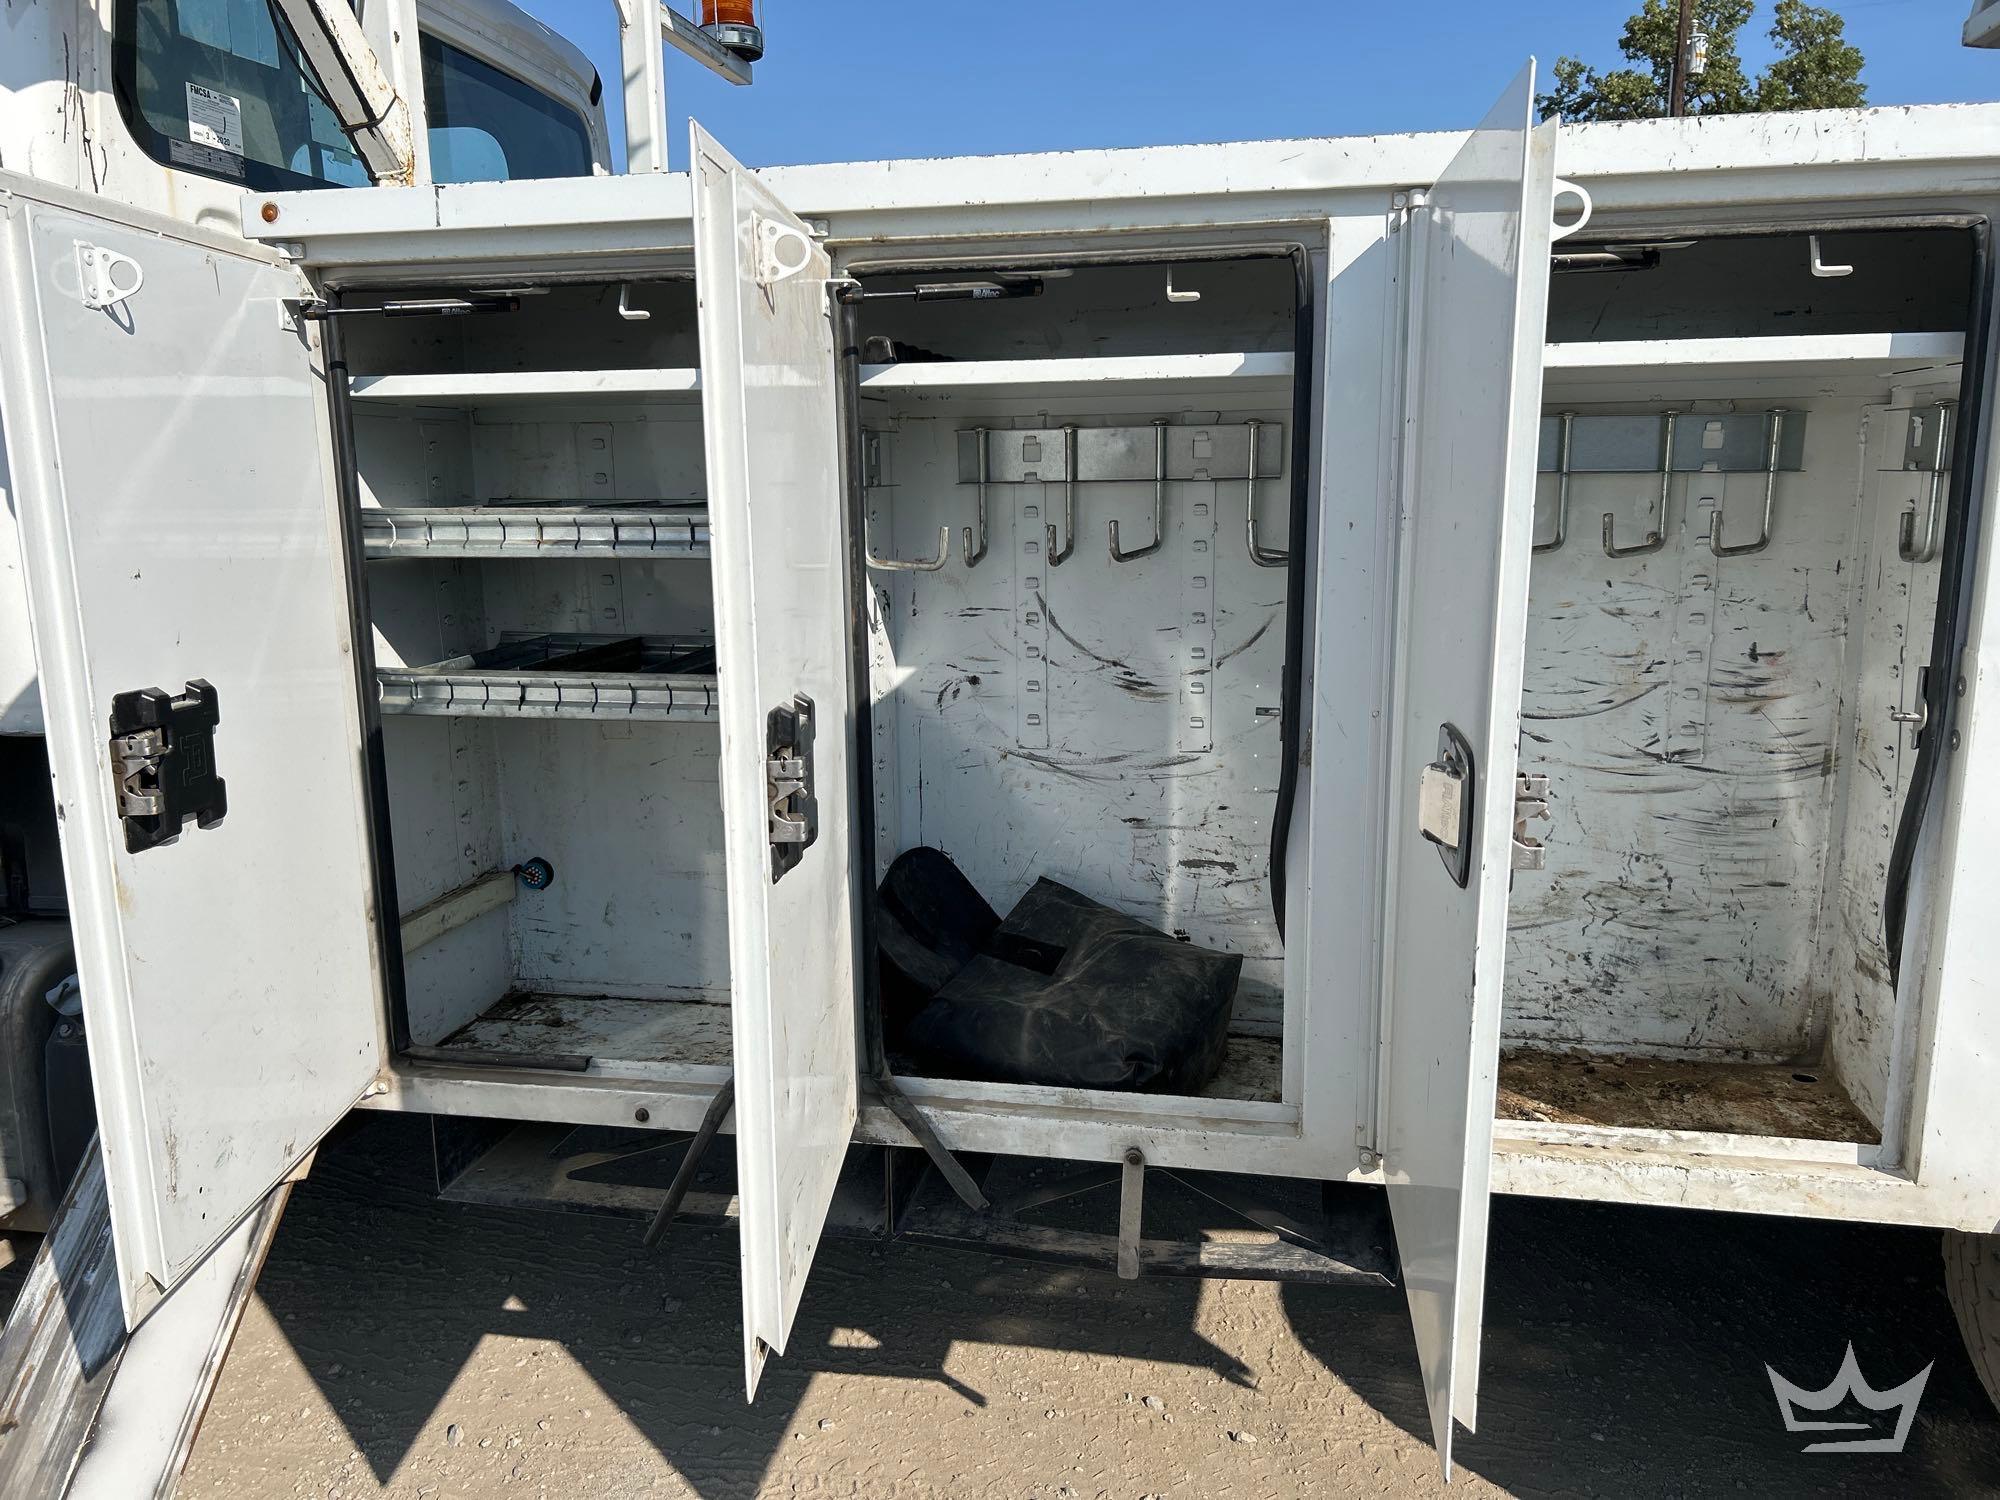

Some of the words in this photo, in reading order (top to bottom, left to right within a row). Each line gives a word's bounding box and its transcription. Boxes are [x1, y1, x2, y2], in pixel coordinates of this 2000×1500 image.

[190, 85, 211, 99] FMCSA
[205, 131, 210, 140] 3
[217, 135, 230, 146] 2020
